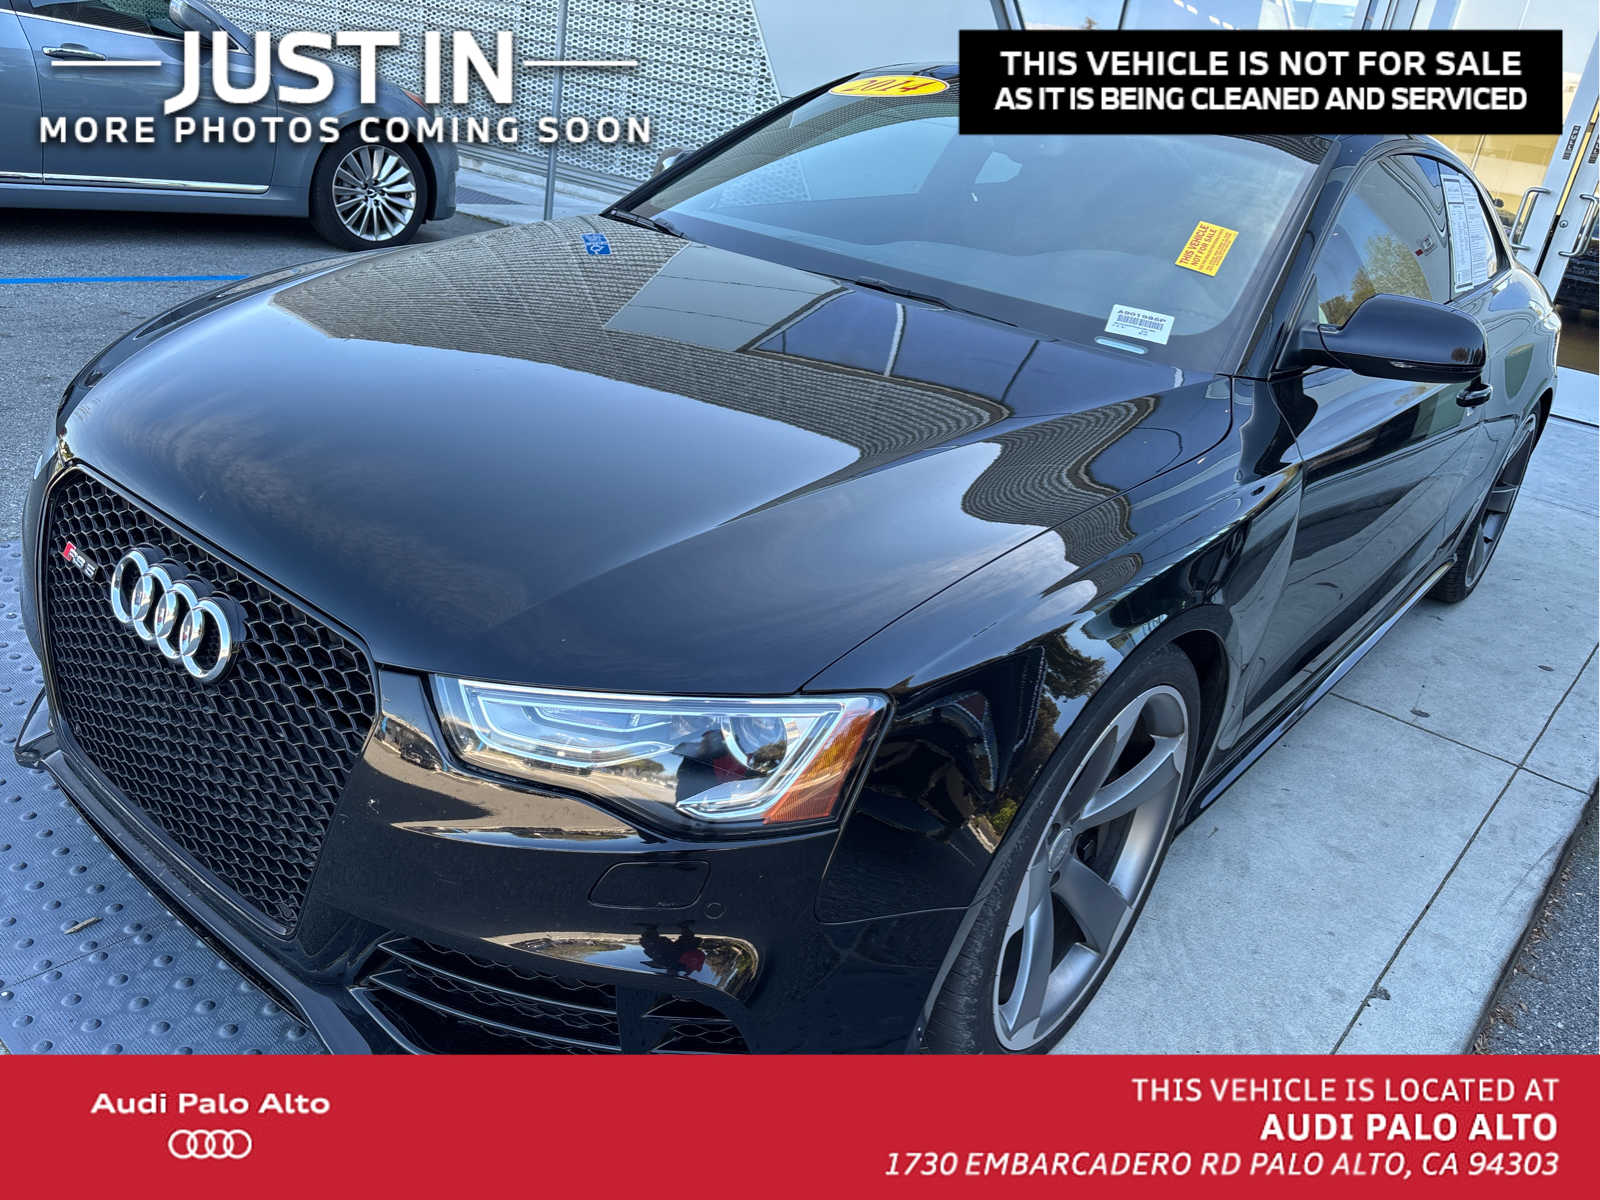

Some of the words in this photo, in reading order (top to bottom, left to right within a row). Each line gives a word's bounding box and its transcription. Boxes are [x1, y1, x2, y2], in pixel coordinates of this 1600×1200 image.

[842, 79, 938, 92] 2014
[1179, 250, 1195, 265] THIS
[1188, 223, 1209, 250] VEHICLE
[1191, 253, 1201, 267] NOT
[1197, 242, 1209, 255] FOR
[1204, 229, 1217, 243] SALE
